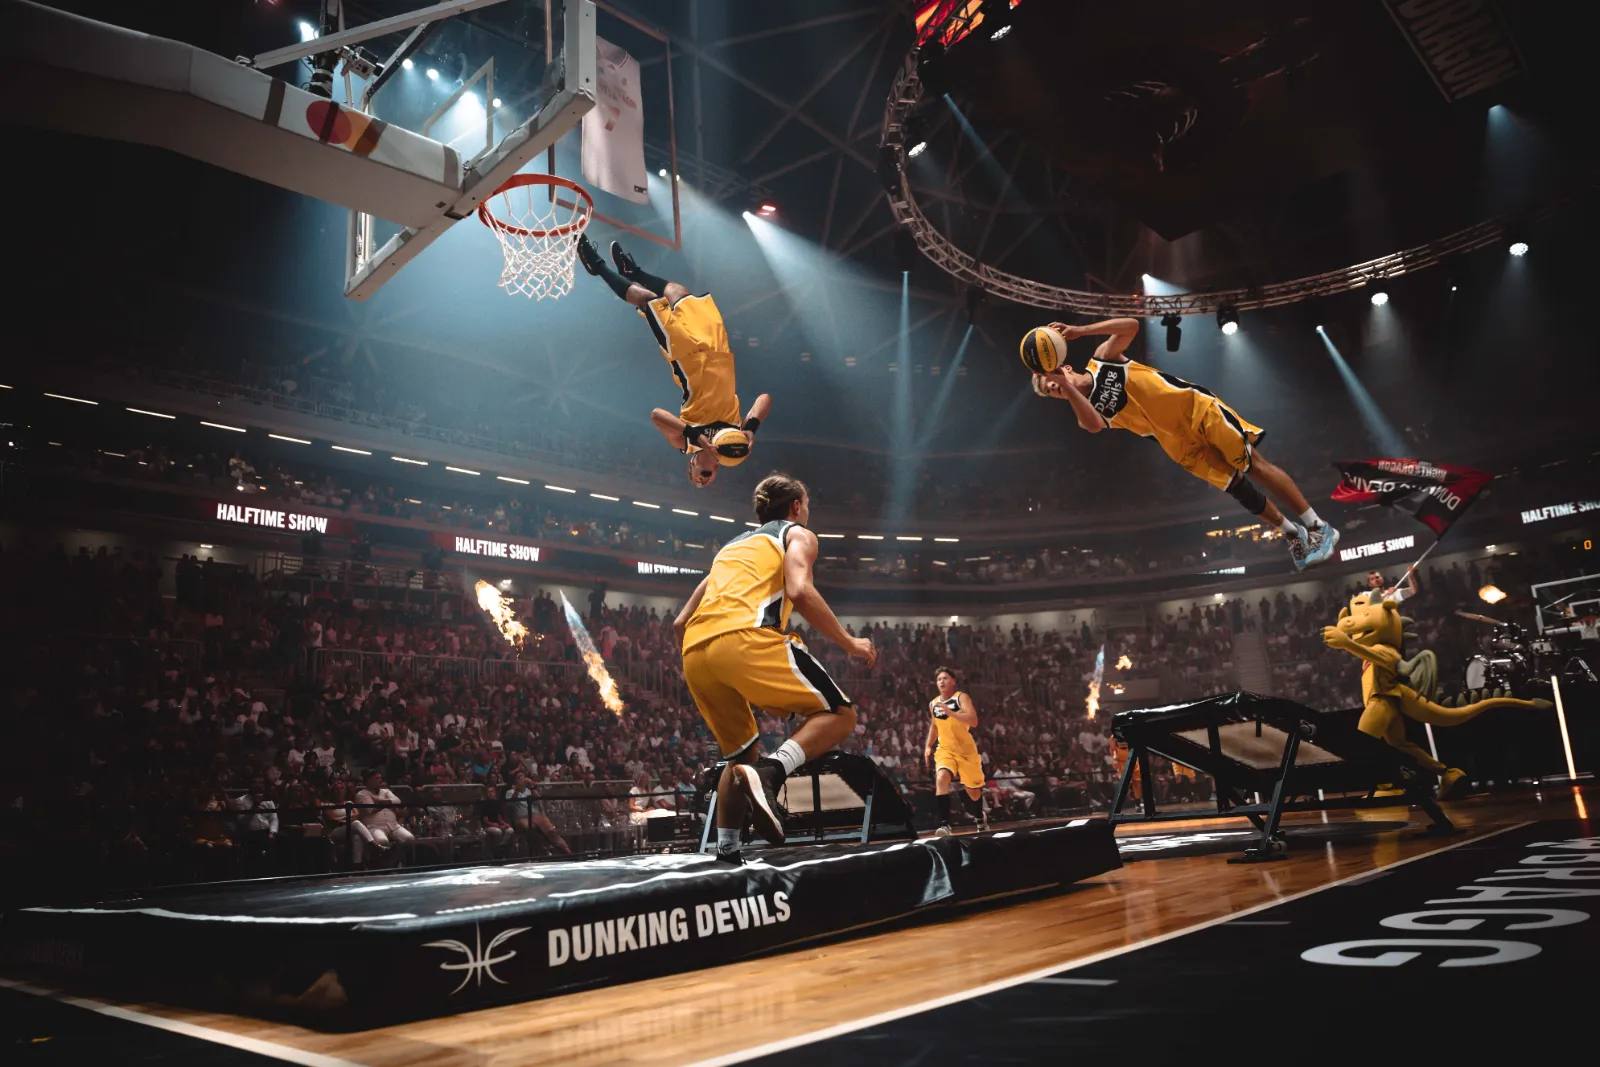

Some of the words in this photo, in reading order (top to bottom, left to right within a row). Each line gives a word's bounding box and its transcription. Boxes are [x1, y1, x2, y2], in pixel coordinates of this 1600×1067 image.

[216, 503, 286, 529] HALFTIME
[288, 513, 328, 534] SHOW
[1520, 503, 1577, 524] HALFTIME
[455, 536, 508, 559] HALFTIME
[509, 544, 540, 562] SHOW
[1339, 541, 1386, 562] HALFTIME
[1386, 535, 1415, 552] SHOW
[1583, 539, 1592, 550] 0
[548, 907, 688, 966] DUNKING
[696, 891, 790, 937] DEVILS
